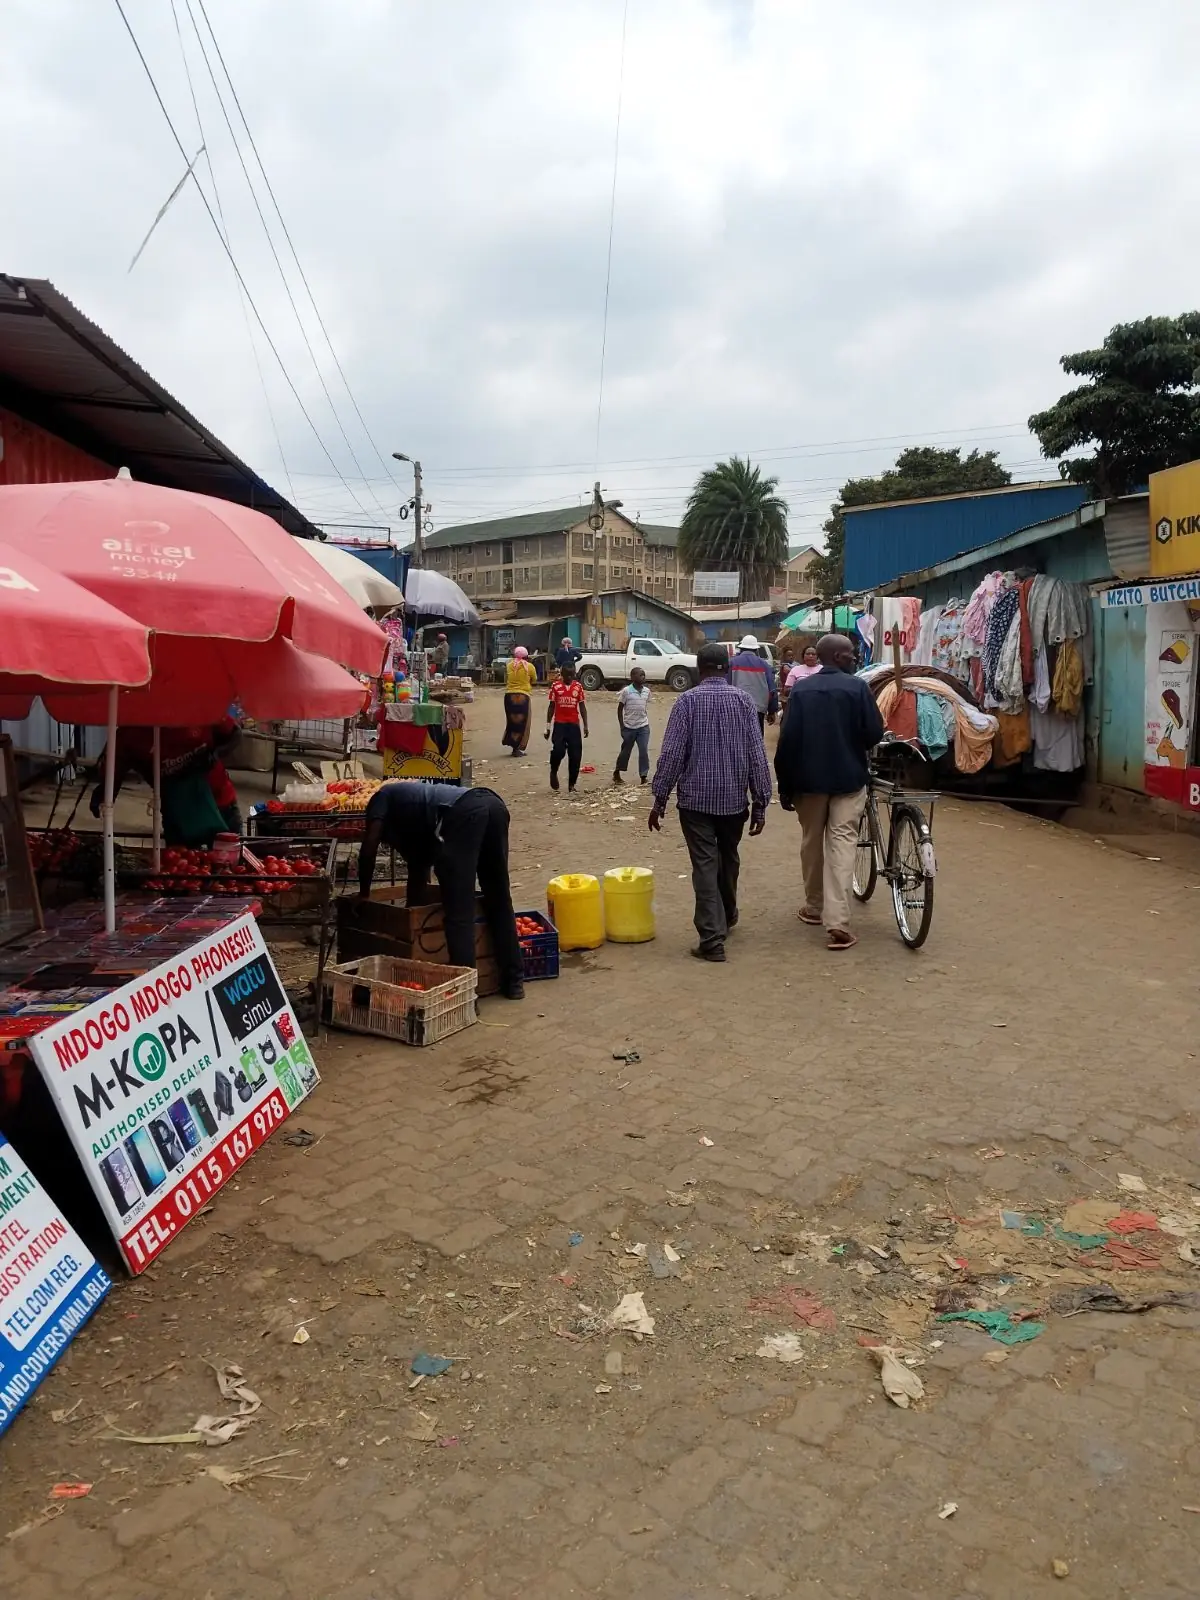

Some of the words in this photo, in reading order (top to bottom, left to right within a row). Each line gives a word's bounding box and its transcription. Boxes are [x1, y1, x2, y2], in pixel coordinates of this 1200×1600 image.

[102, 538, 196, 560] airtel
[110, 552, 185, 568] money
[1107, 587, 1143, 606] MZITO
[1150, 581, 1200, 603] BUTCH
[884, 630, 907, 646] 20
[53, 1002, 131, 1072] MDOGO
[130, 965, 192, 1023] MDOGO
[190, 925, 257, 984] PHONES!!!
[223, 963, 266, 1005] watu
[242, 997, 273, 1031] simu
[73, 1014, 201, 1129] M-KOPA
[91, 1087, 171, 1159] AUTHORISED
[172, 1054, 213, 1092] DEALER
[0, 1171, 36, 1220] MENT
[126, 1211, 176, 1265] TEL:
[175, 1156, 223, 1217] 0115
[222, 1122, 254, 1168] 167
[253, 1095, 284, 1136] 978
[0, 1219, 30, 1260] RTEL
[0, 1217, 68, 1304] GISTRATION
[5, 1277, 58, 1337] TELCOM
[50, 1254, 82, 1289] REG.
[0, 1373, 30, 1412] AND
[20, 1326, 68, 1382] COVERS
[58, 1269, 111, 1335] AVAILABLE
